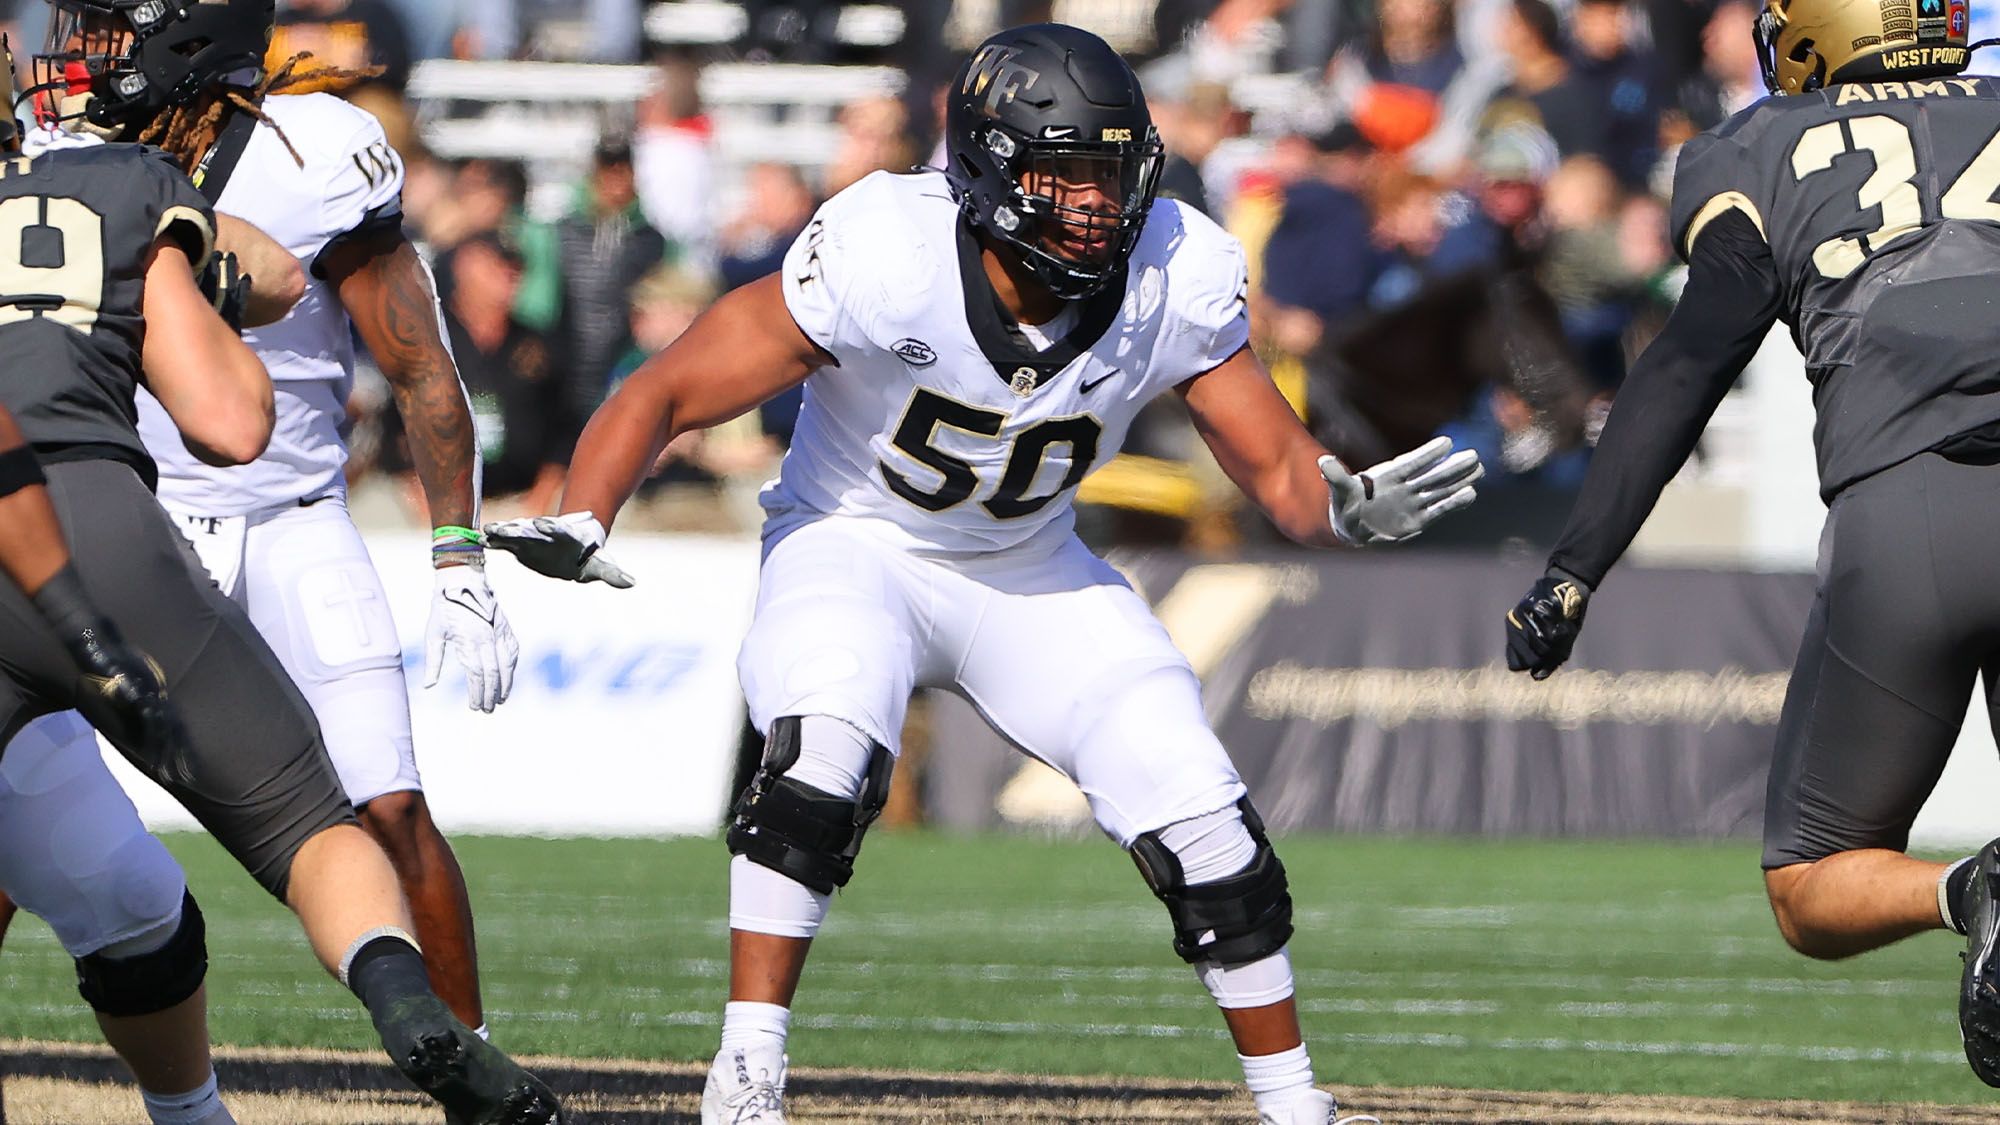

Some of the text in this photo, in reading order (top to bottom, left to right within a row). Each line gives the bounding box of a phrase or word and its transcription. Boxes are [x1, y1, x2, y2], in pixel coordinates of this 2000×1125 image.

[1881, 47, 1967, 70] WEST POINT
[1836, 78, 1981, 106] ARMY
[1102, 127, 1132, 142] DEACS
[899, 343, 931, 359] ACC
[879, 384, 1104, 520] 50
